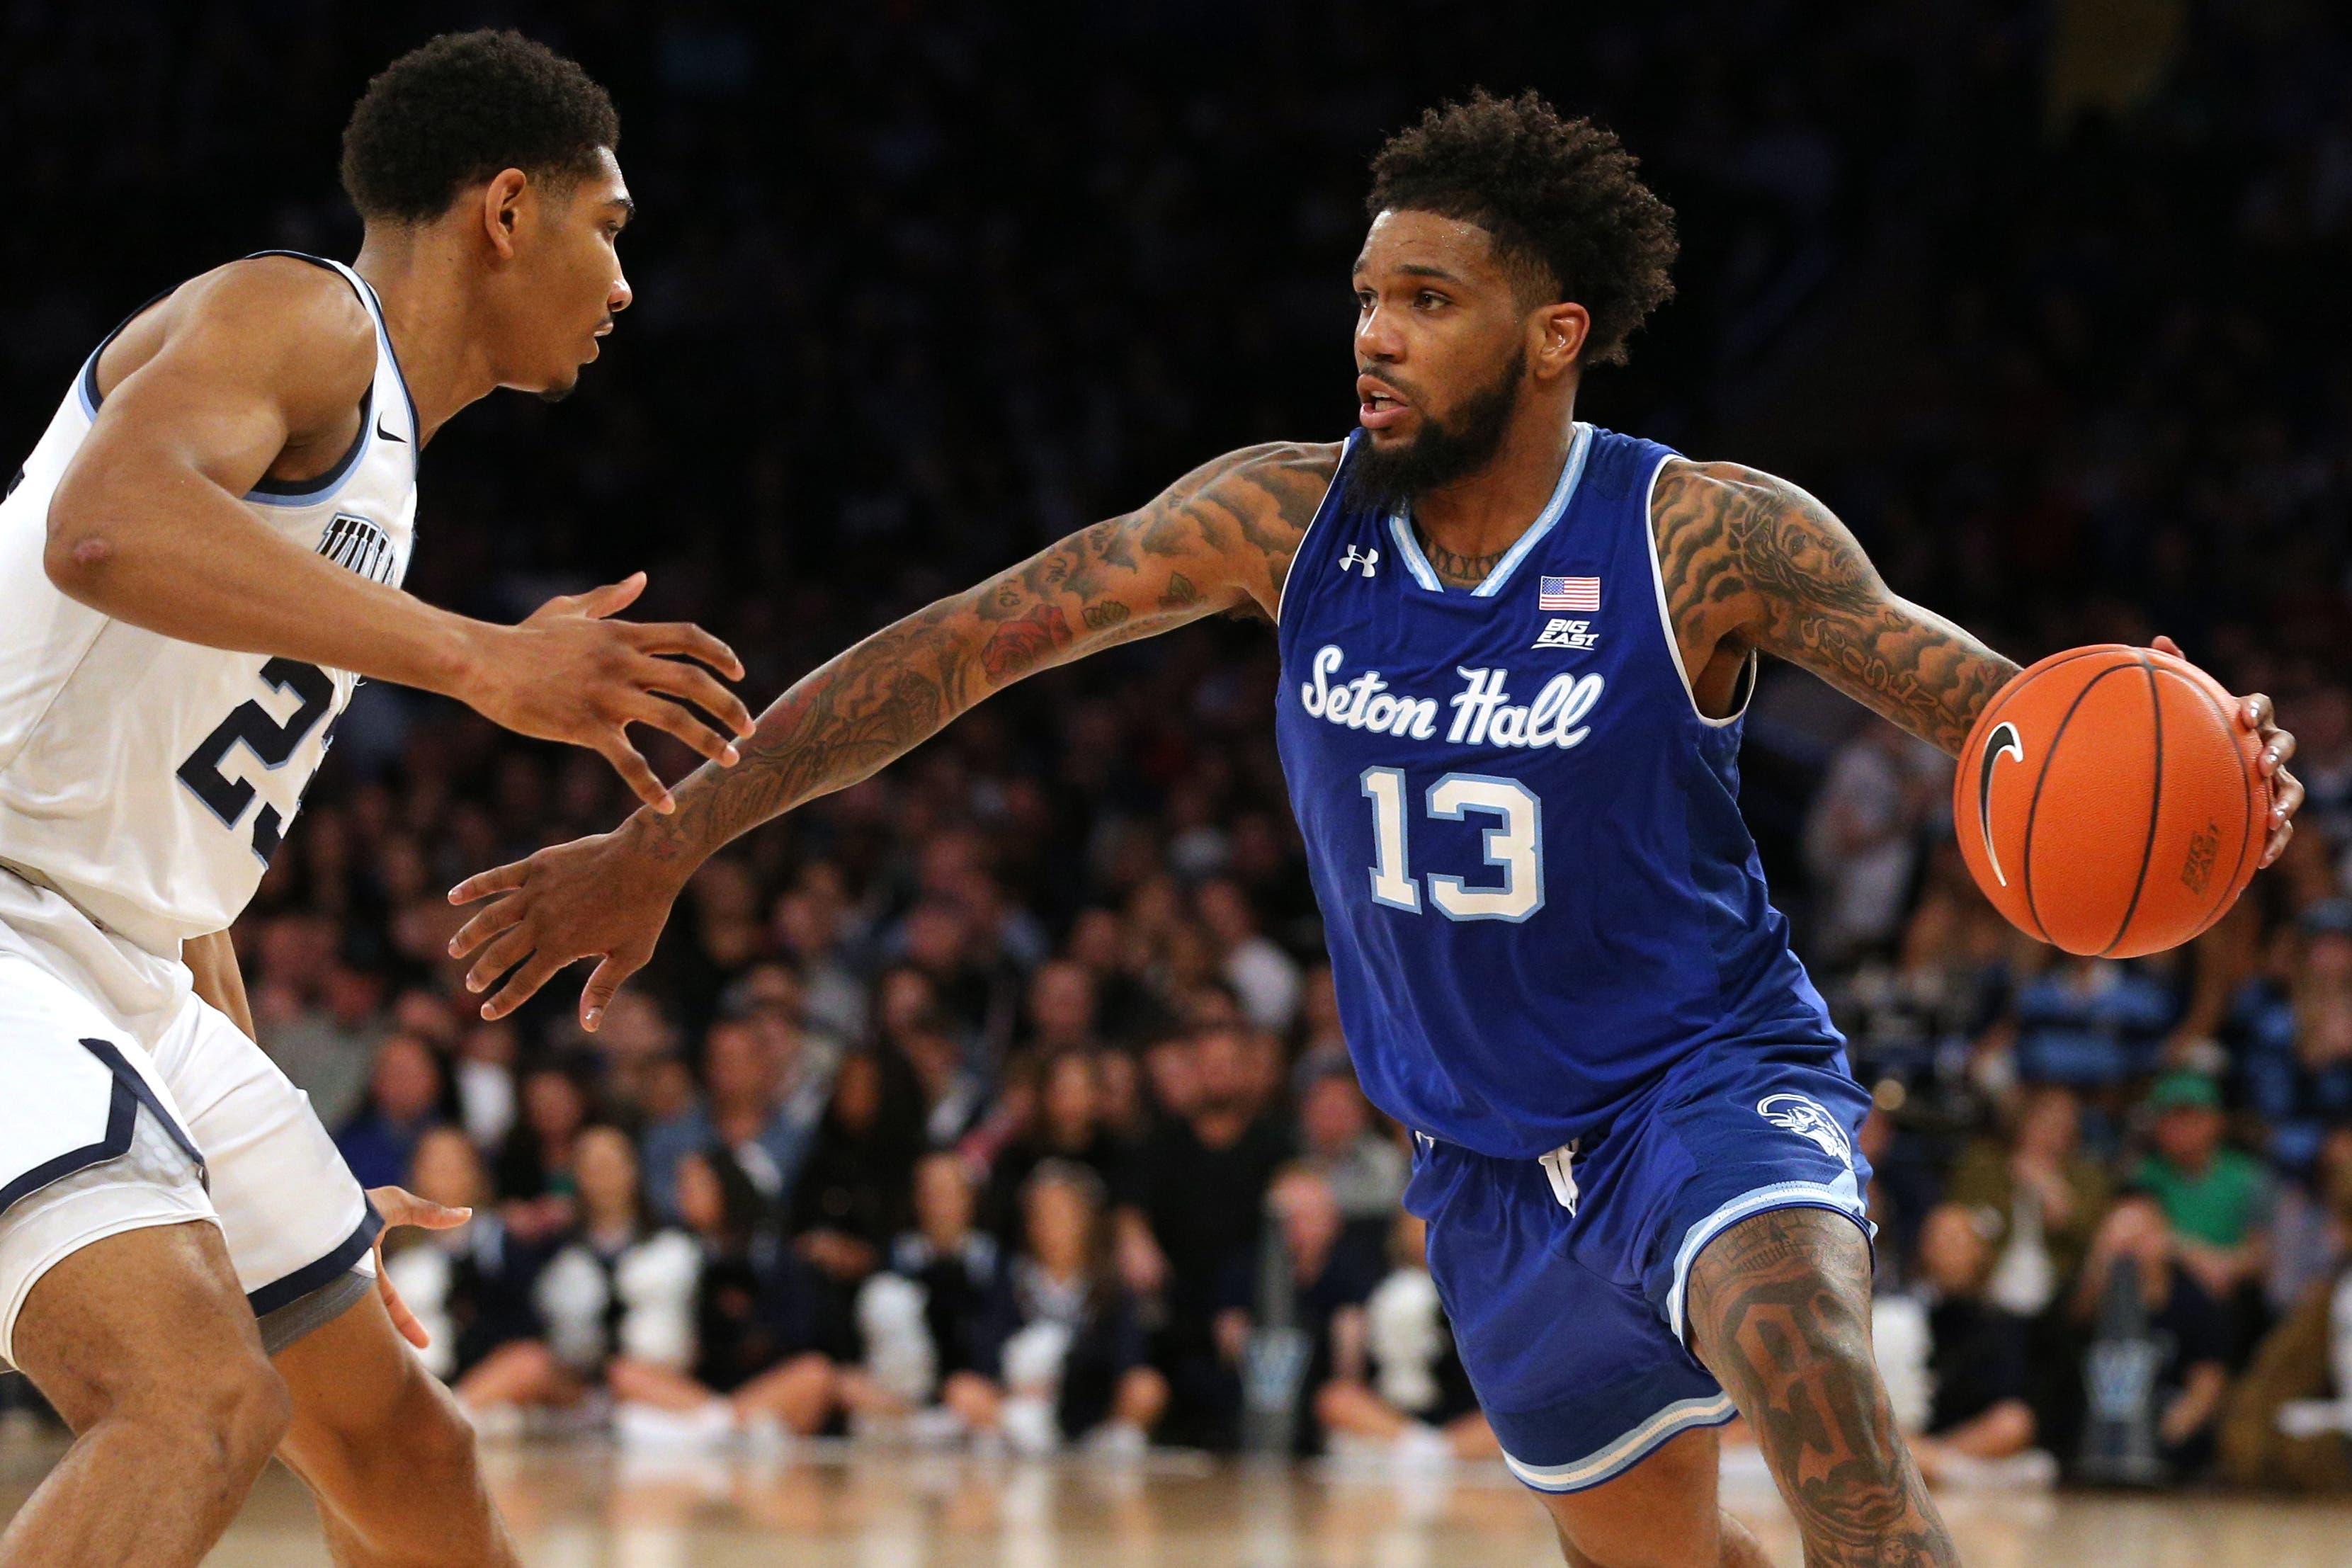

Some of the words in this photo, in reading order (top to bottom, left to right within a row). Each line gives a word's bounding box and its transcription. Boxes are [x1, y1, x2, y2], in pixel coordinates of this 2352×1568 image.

[1536, 630, 1600, 647] EAST
[1544, 618, 1591, 634] BIG
[1301, 644, 1440, 741] Seton
[1445, 666, 1606, 749] Hall
[1359, 765, 1546, 924] 13
